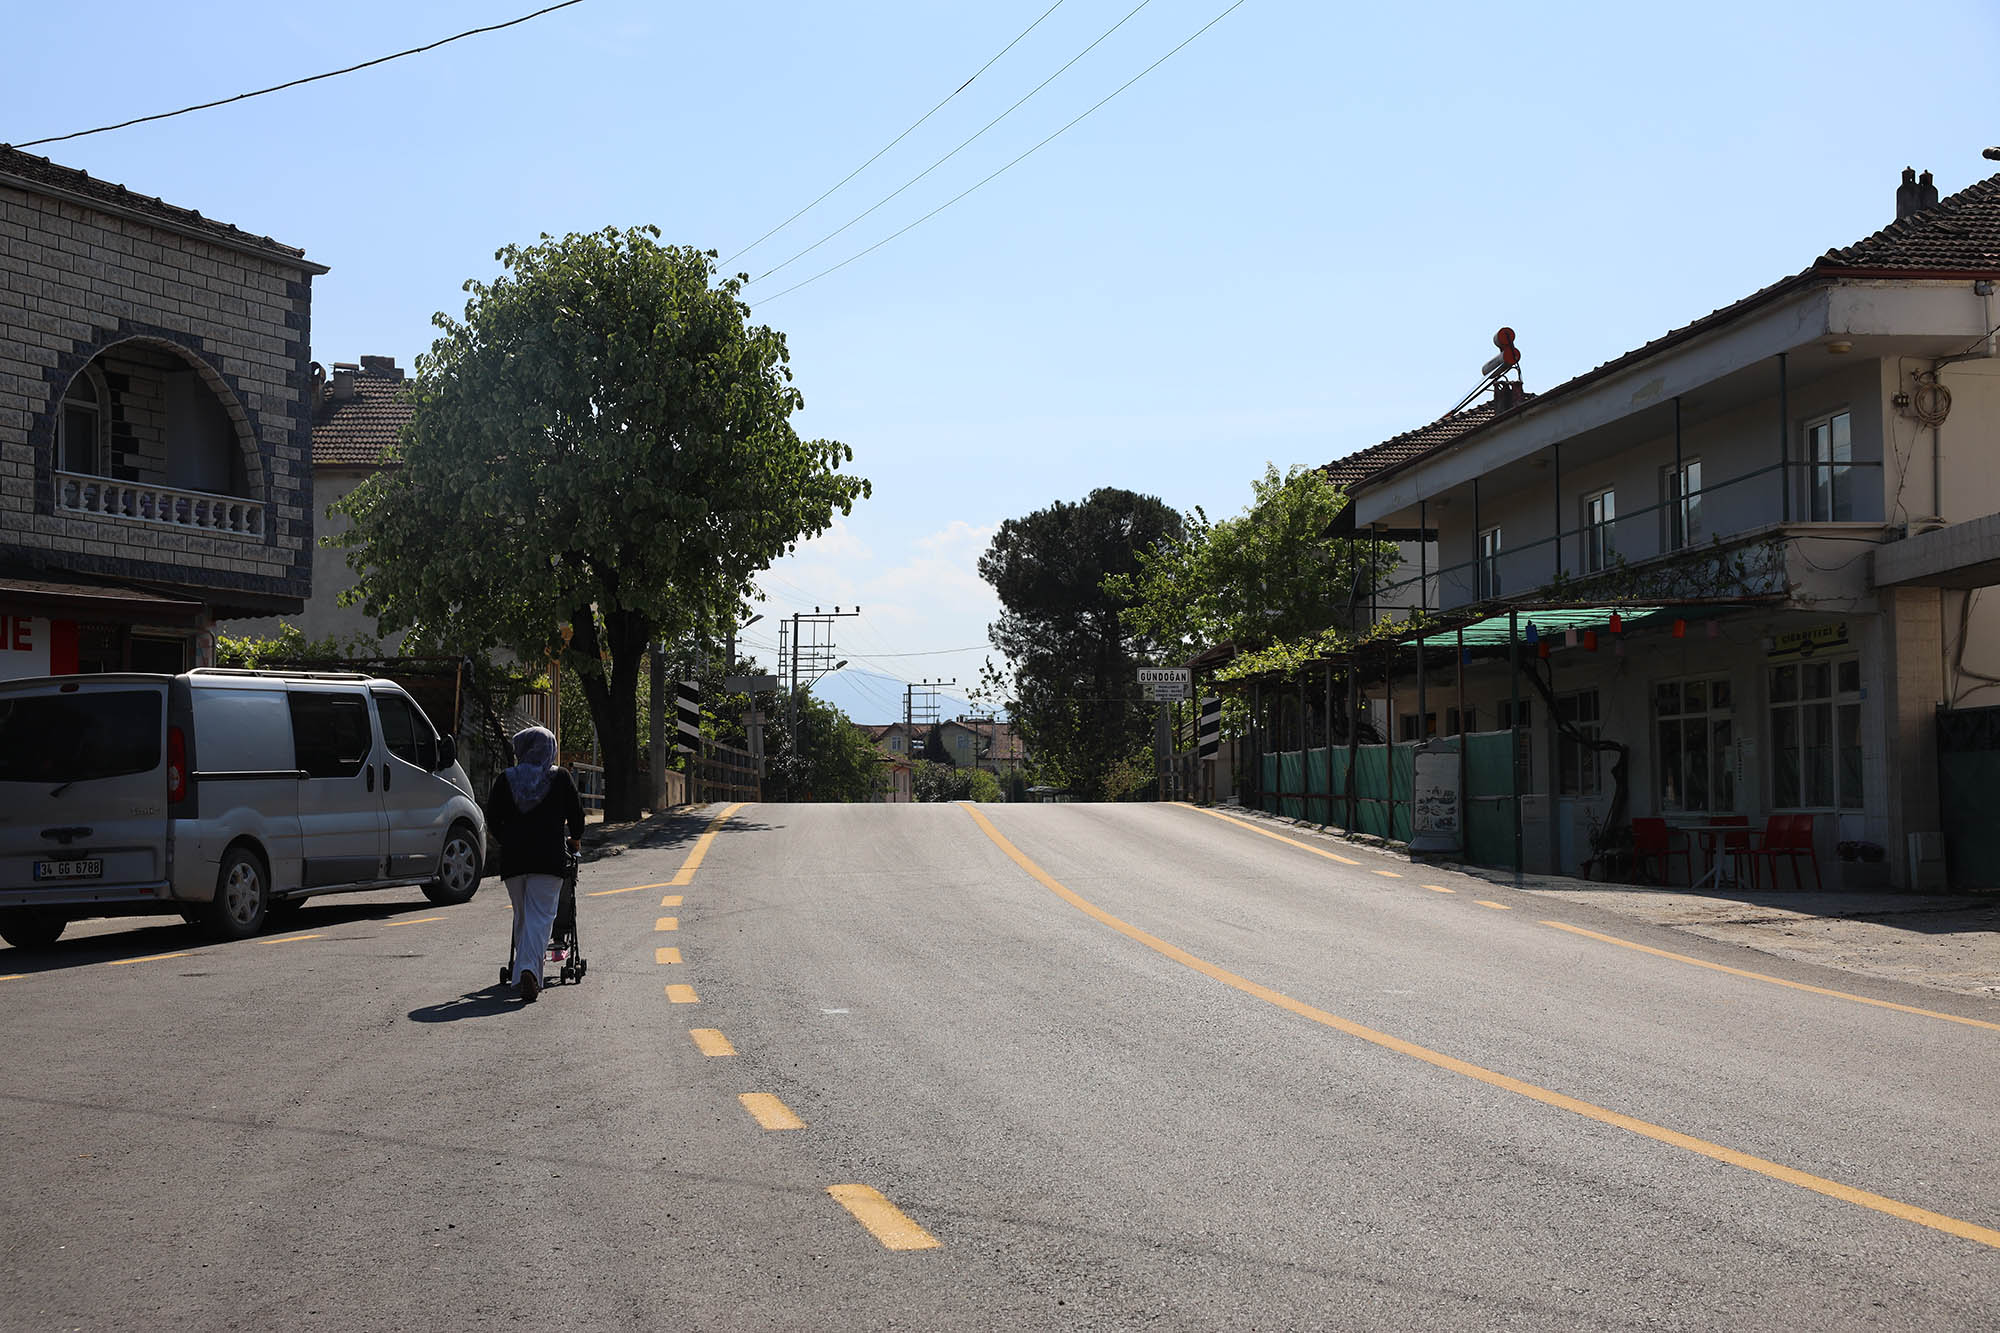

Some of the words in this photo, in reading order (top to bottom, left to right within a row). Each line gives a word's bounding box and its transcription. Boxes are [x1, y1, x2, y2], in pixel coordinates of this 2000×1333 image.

[1140, 670, 1187, 681] GÜNDOĞAN
[41, 864, 52, 875] 34
[58, 863, 70, 874] GG
[76, 861, 100, 874] 6788
